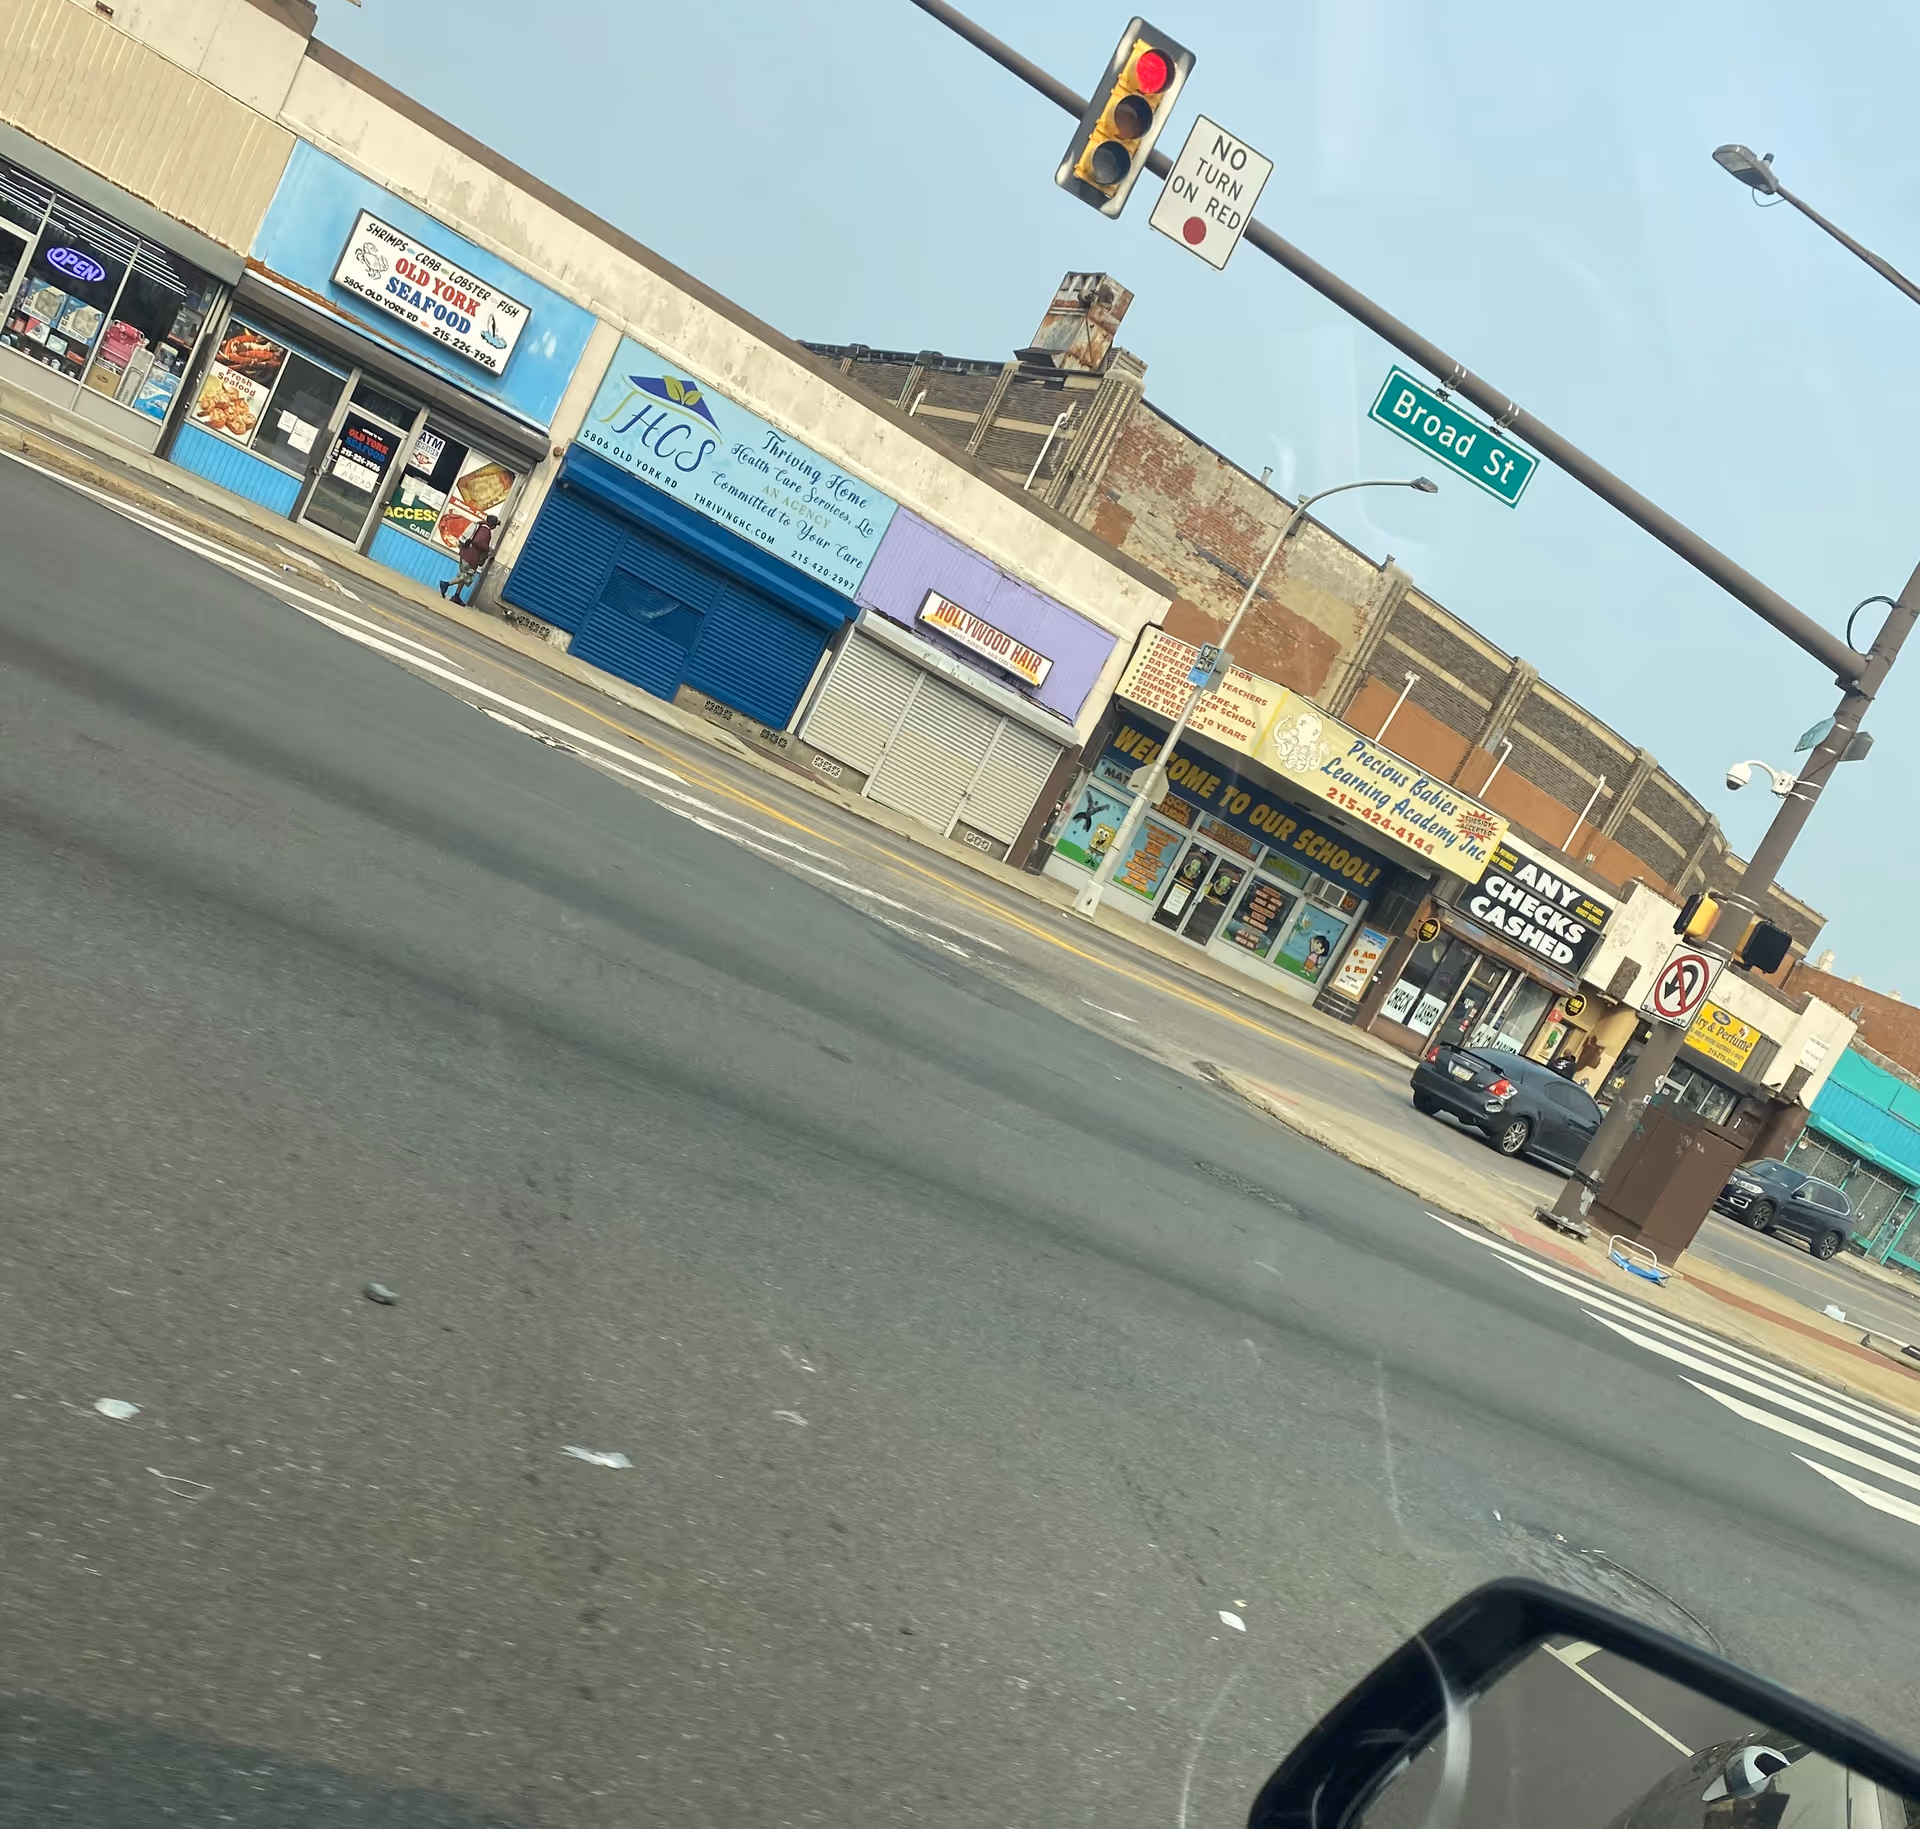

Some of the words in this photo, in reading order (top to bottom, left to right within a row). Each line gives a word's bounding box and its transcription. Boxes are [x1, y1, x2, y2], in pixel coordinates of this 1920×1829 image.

[1211, 135, 1247, 171] NO
[1172, 175, 1199, 204] ON
[1204, 196, 1241, 230] RED
[1196, 157, 1244, 202] TURN
[51, 248, 101, 281] OPEN
[366, 223, 409, 252] SHRIMPS
[415, 253, 442, 272] CRAB
[449, 272, 491, 301] LOBSTER
[497, 300, 520, 318] FISH
[395, 258, 430, 287] OLD
[430, 277, 481, 317] YORK
[343, 276, 364, 292] 5804
[365, 286, 383, 303] OLD
[384, 298, 406, 317] YORK
[407, 311, 419, 323] RD
[433, 326, 496, 368] 215-224-7926
[385, 277, 471, 335] SEAFOOD
[217, 372, 256, 397] Seafood
[345, 436, 386, 463] SEAFOOD
[348, 428, 366, 442] OLD
[366, 436, 390, 455] YORK
[420, 431, 443, 450] ATM
[1392, 388, 1477, 458] Broad
[1482, 448, 1515, 485] St
[731, 443, 770, 474] Health
[774, 467, 802, 493] Care
[761, 430, 822, 485] Thriving
[825, 474, 868, 509] Home
[384, 505, 438, 521] ACCESS
[583, 429, 609, 450] 5806
[613, 446, 632, 463] OLD
[636, 458, 661, 480] YORK
[664, 477, 678, 489] RD
[693, 492, 775, 545] THRIVINGHC.COM
[791, 550, 855, 591] 215-420-2997
[712, 470, 776, 519] Committed
[779, 510, 791, 527] to
[797, 520, 831, 549] Your
[835, 543, 863, 569] Care
[761, 484, 780, 500] AN
[781, 496, 832, 529] AGENCY
[935, 600, 1011, 656] HOLLYWOOD
[1009, 644, 1043, 674] HAIR
[1155, 643, 1179, 658] FREE
[1159, 636, 1182, 652] FREE
[1137, 678, 1179, 700] SUMMER
[1144, 664, 1197, 691] PRE-SCHOO
[1210, 694, 1240, 712] PRE-K
[1148, 657, 1168, 669] DAY
[1169, 667, 1188, 679] CAR
[1152, 650, 1191, 672] DEGREED
[1222, 681, 1268, 706] TEACHERS
[1130, 691, 1159, 709] STATE
[1160, 705, 1205, 731] LICESED
[1133, 685, 1153, 698] AGE
[1154, 693, 1162, 701] 6
[1203, 717, 1215, 727] 10
[1216, 723, 1248, 742] YEARS
[1140, 671, 1178, 692] BEFORE
[1179, 687, 1186, 696] &
[1220, 708, 1257, 729] SCHOOL
[1104, 767, 1130, 785] MAT
[1347, 739, 1410, 788] Precious
[1409, 776, 1459, 817] Babies
[1113, 725, 1221, 799] WELOME
[1218, 785, 1251, 815] TO
[1249, 804, 1297, 841] OUR
[1292, 829, 1381, 887] SCHOOL!
[1320, 757, 1392, 809] Learning
[1389, 798, 1460, 849] Academy
[1458, 835, 1487, 864] Inc.
[1326, 786, 1435, 856] 215-424-4144
[1465, 816, 1492, 828] SUBSIDY
[1459, 823, 1493, 837] ACCEPTED
[1515, 863, 1581, 908] ANY
[1470, 895, 1574, 964] CASHED
[1485, 876, 1586, 944] CHECKS
[1345, 964, 1351, 972] 6
[1353, 949, 1359, 957] 6
[1707, 1023, 1715, 1034] &
[1717, 1026, 1753, 1053] Perfume
